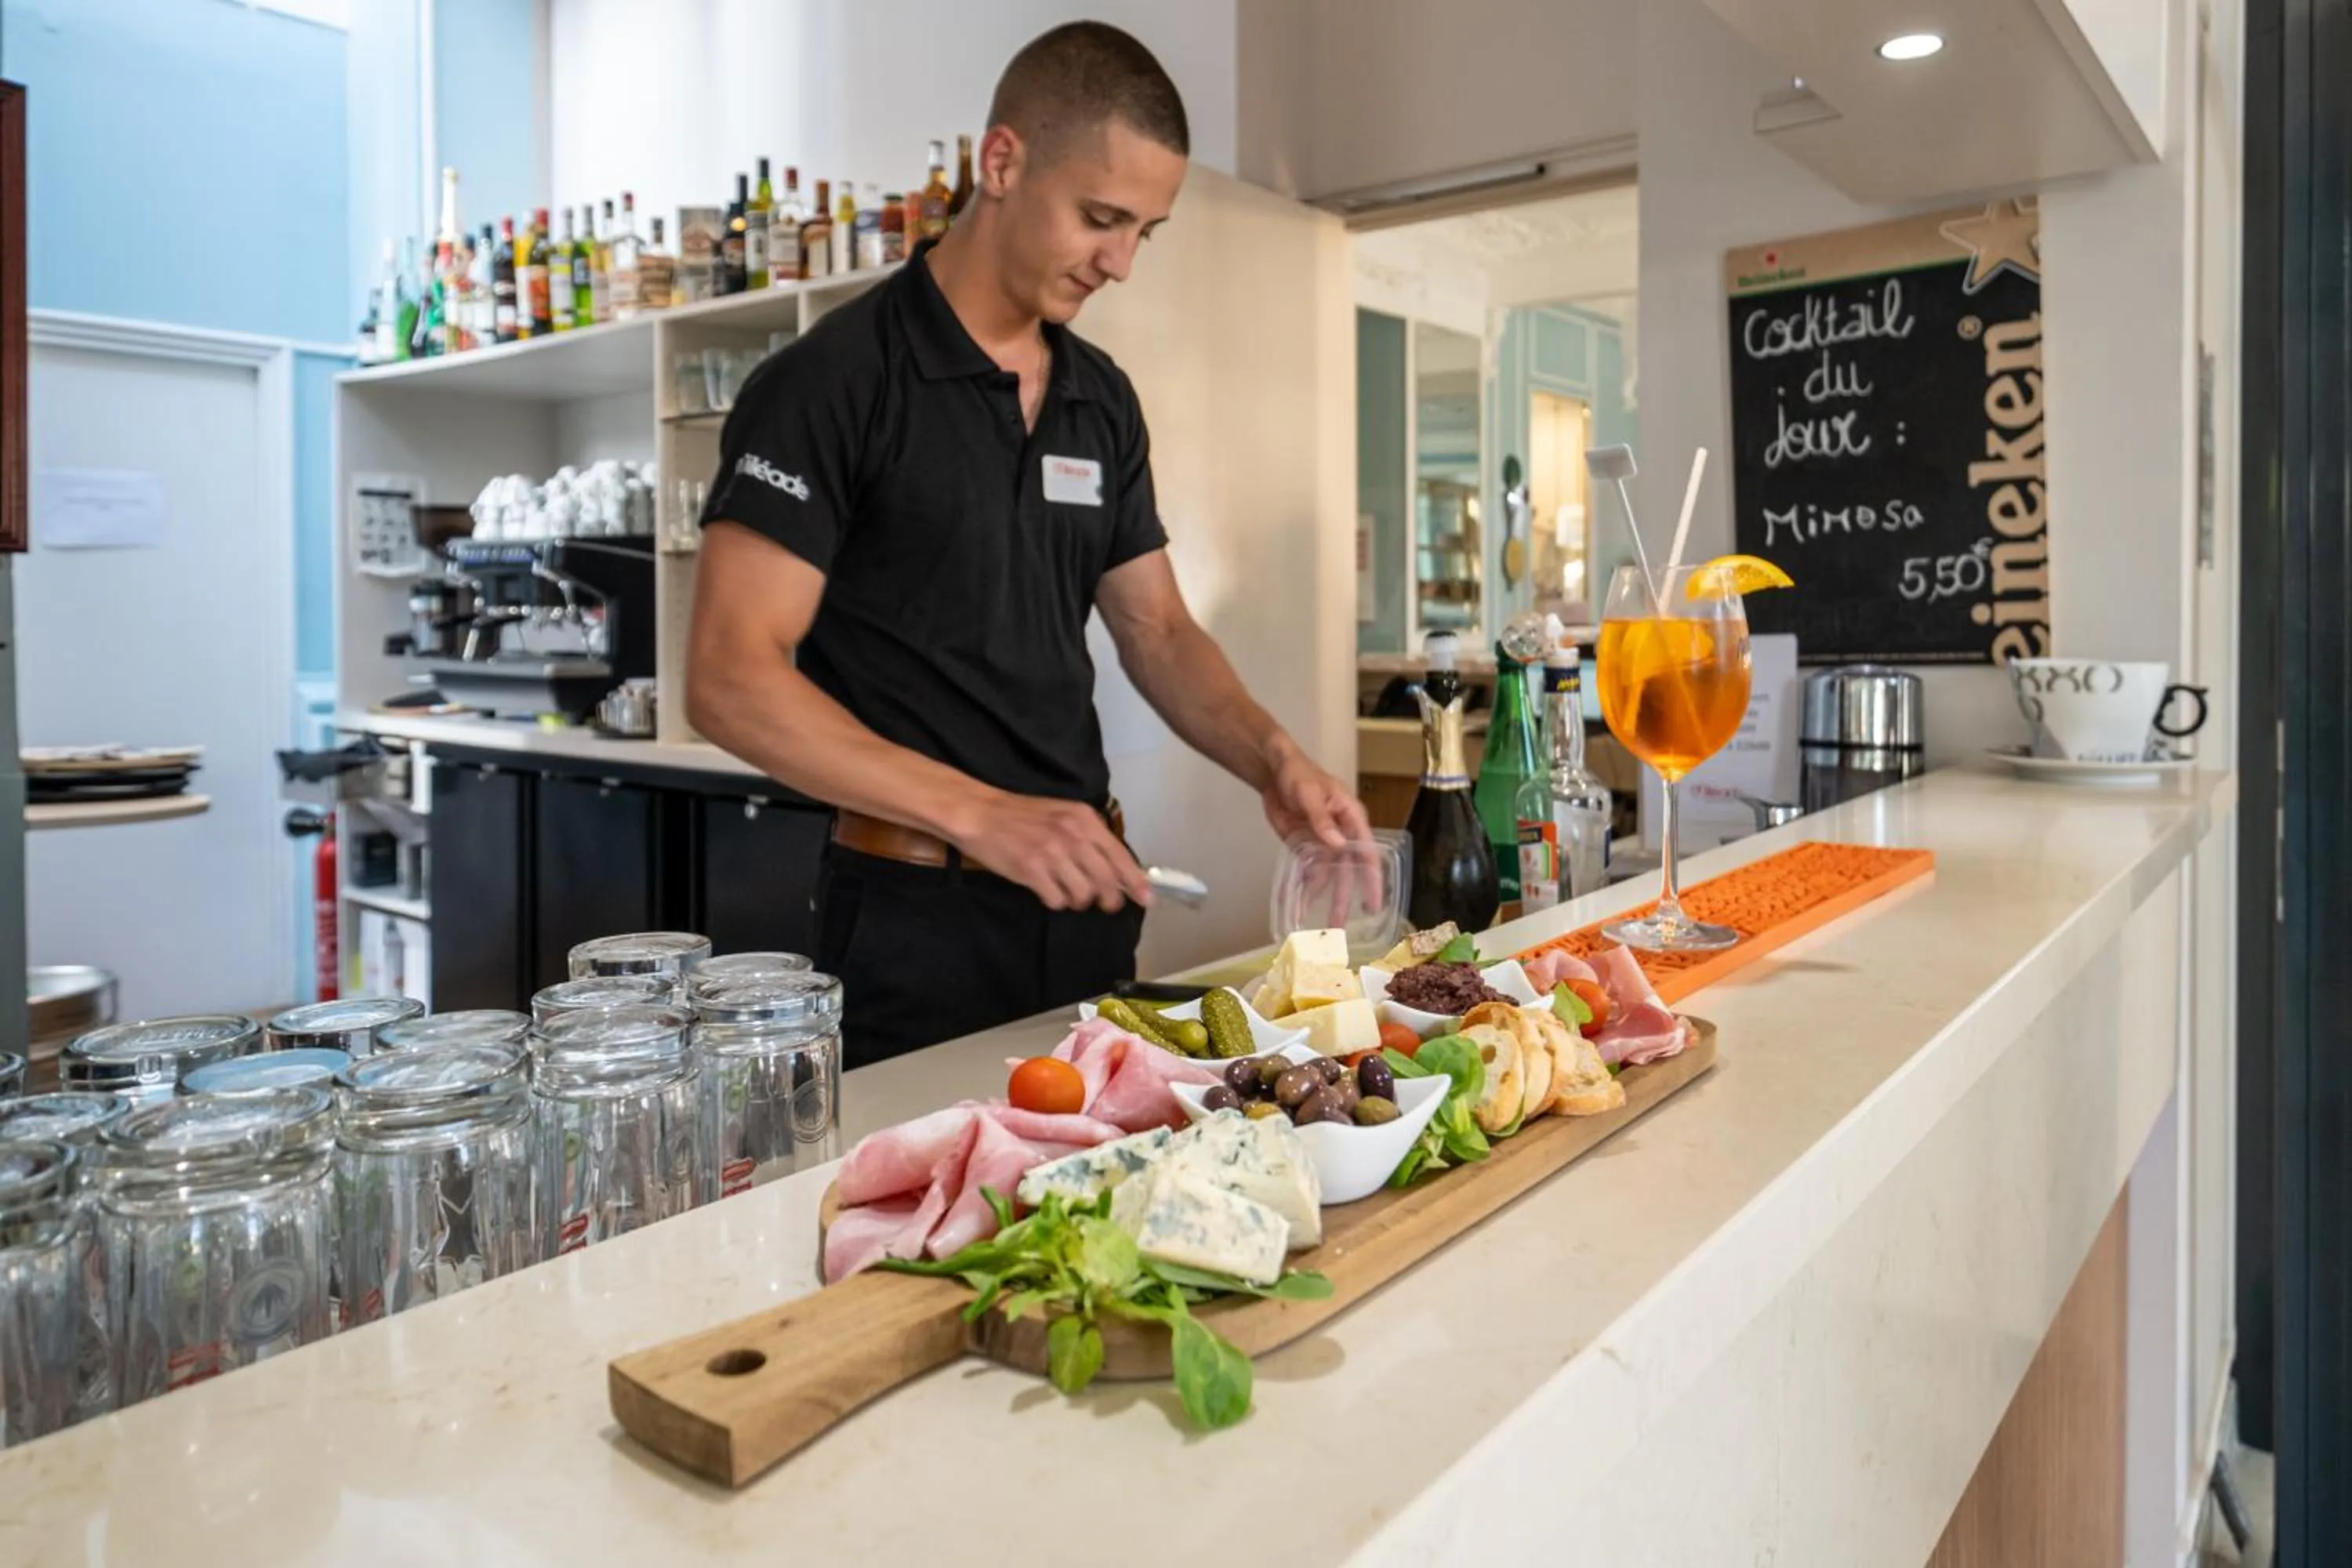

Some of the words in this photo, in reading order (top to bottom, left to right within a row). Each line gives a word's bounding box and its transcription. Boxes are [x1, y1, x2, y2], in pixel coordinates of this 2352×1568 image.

[1744, 278, 1915, 359] Cocktail
[1804, 348, 1875, 403] du
[1764, 386, 1872, 469] jour
[1762, 499, 1924, 547] Mimosa
